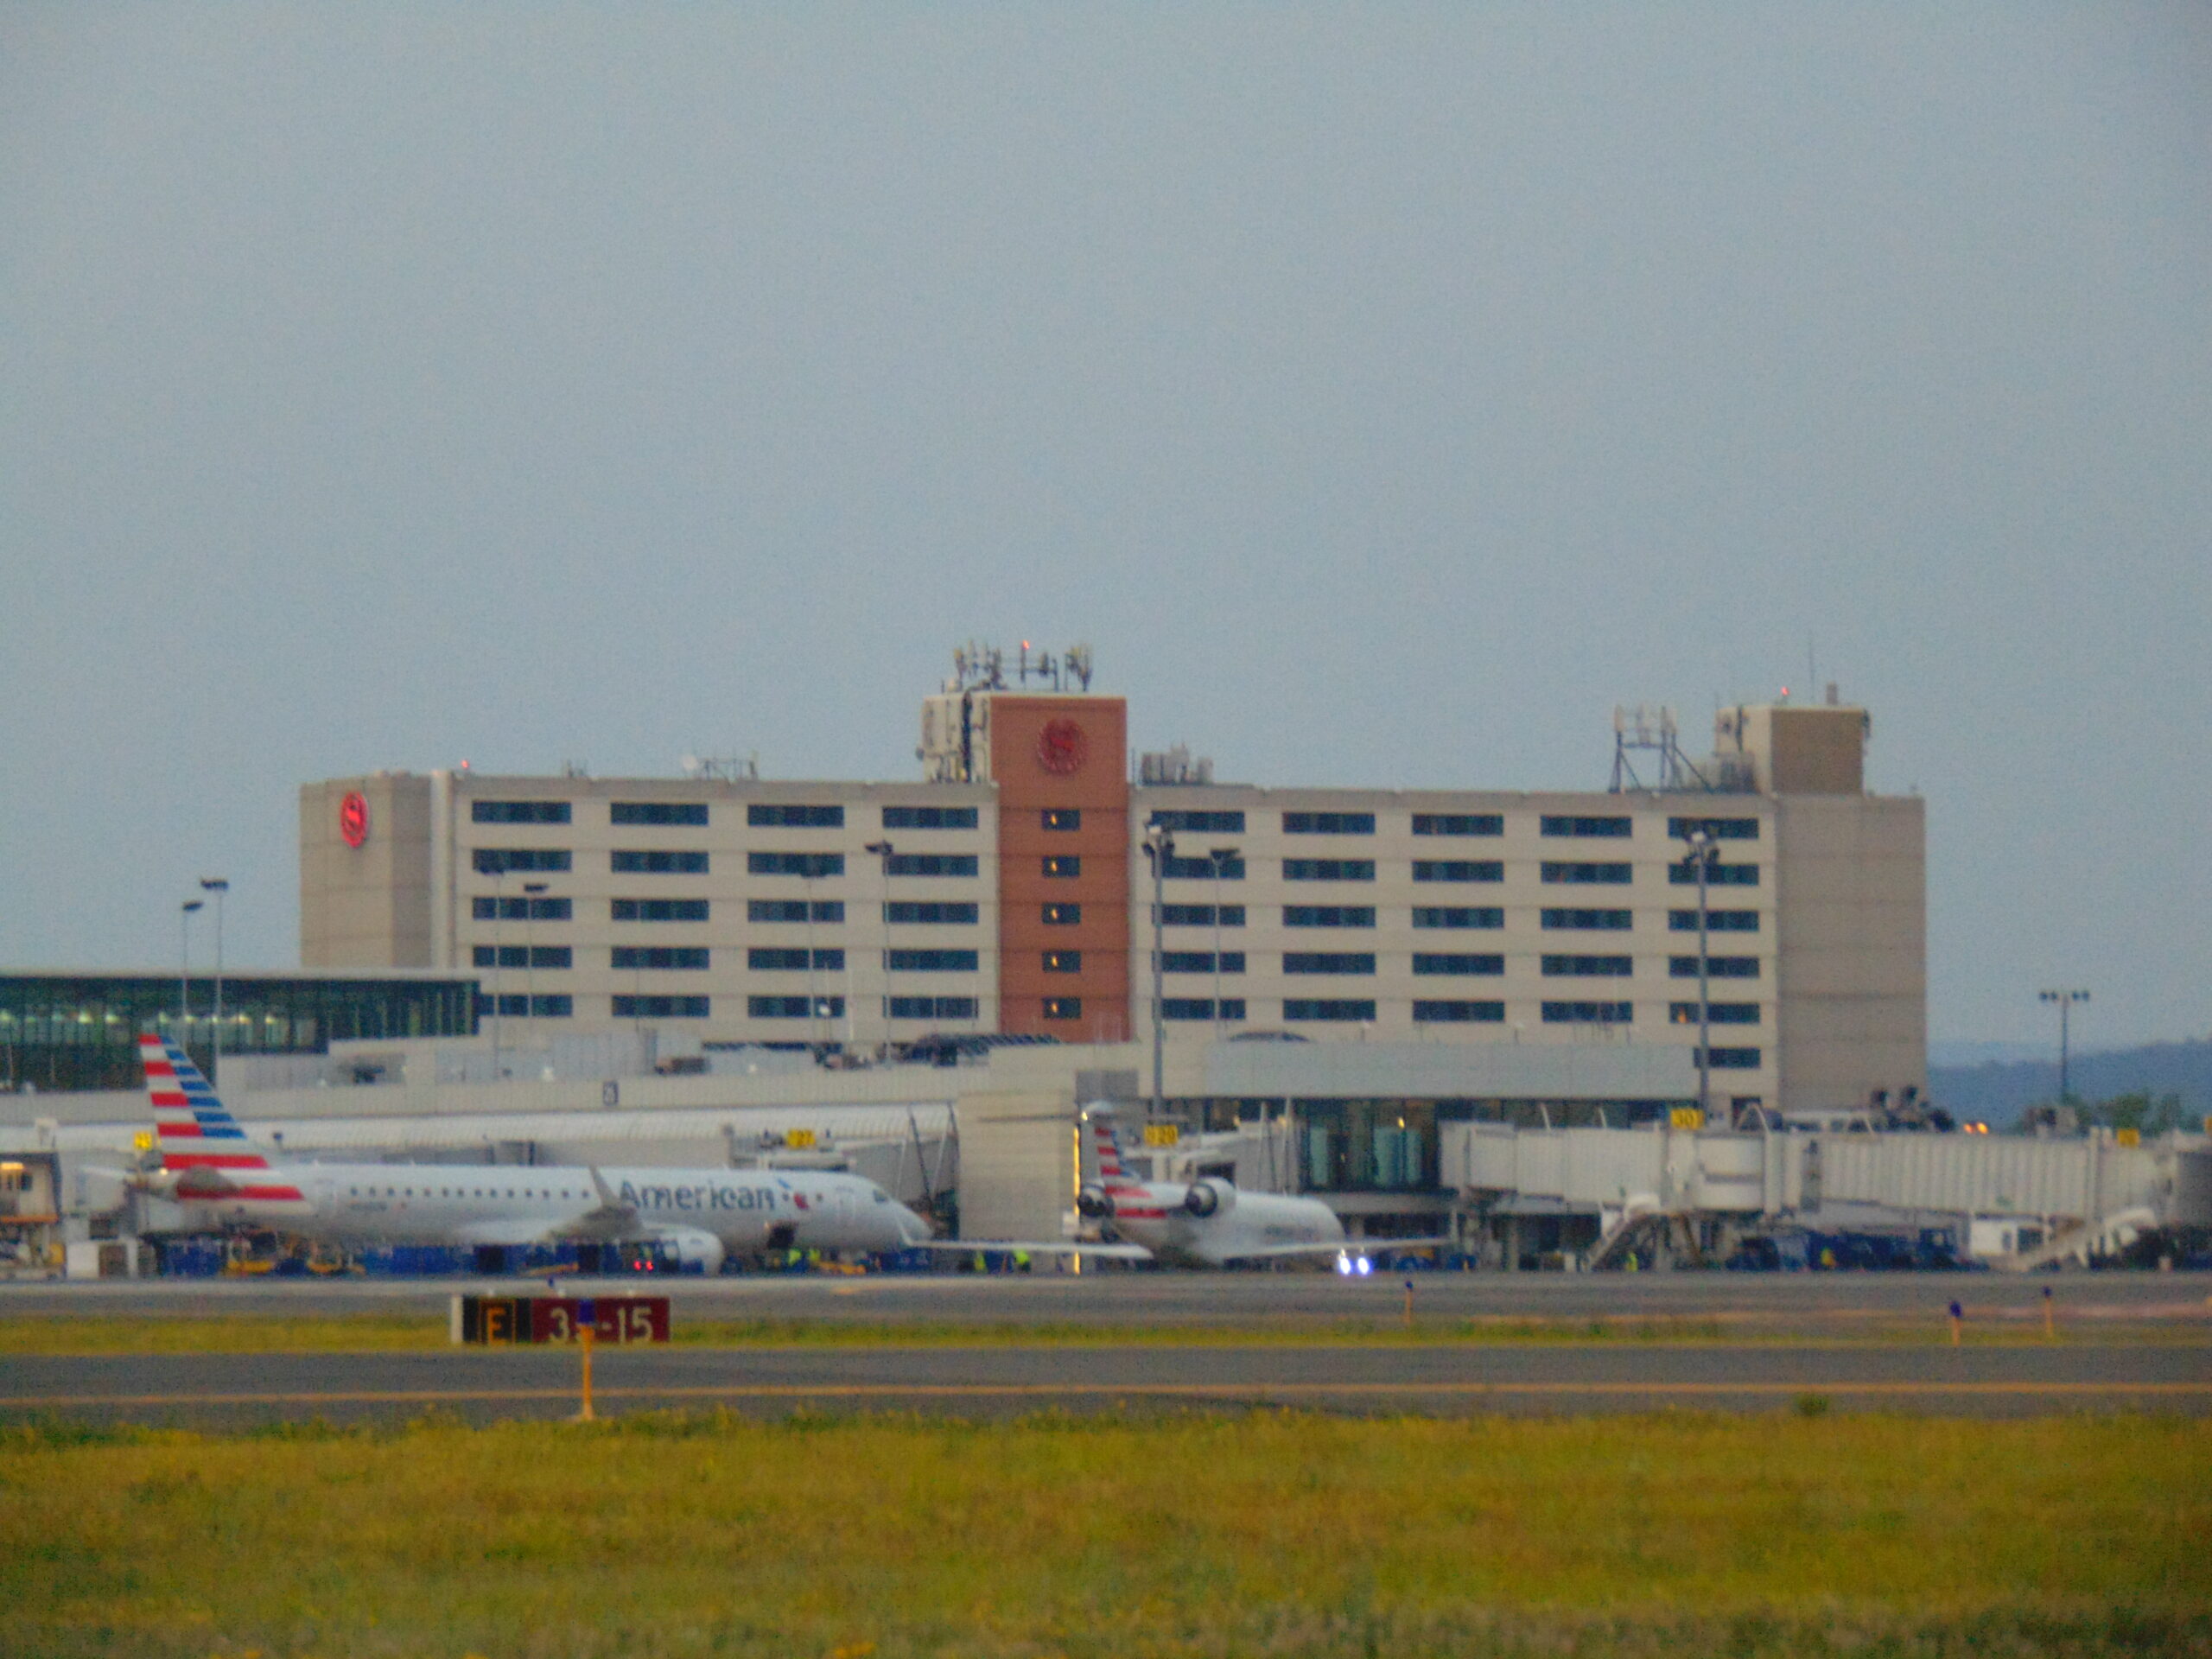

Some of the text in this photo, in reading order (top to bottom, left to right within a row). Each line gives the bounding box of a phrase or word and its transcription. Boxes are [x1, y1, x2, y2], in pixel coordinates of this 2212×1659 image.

[620, 1179, 776, 1211] American
[486, 1307, 506, 1347] E
[549, 1306, 653, 1346] 3-15
